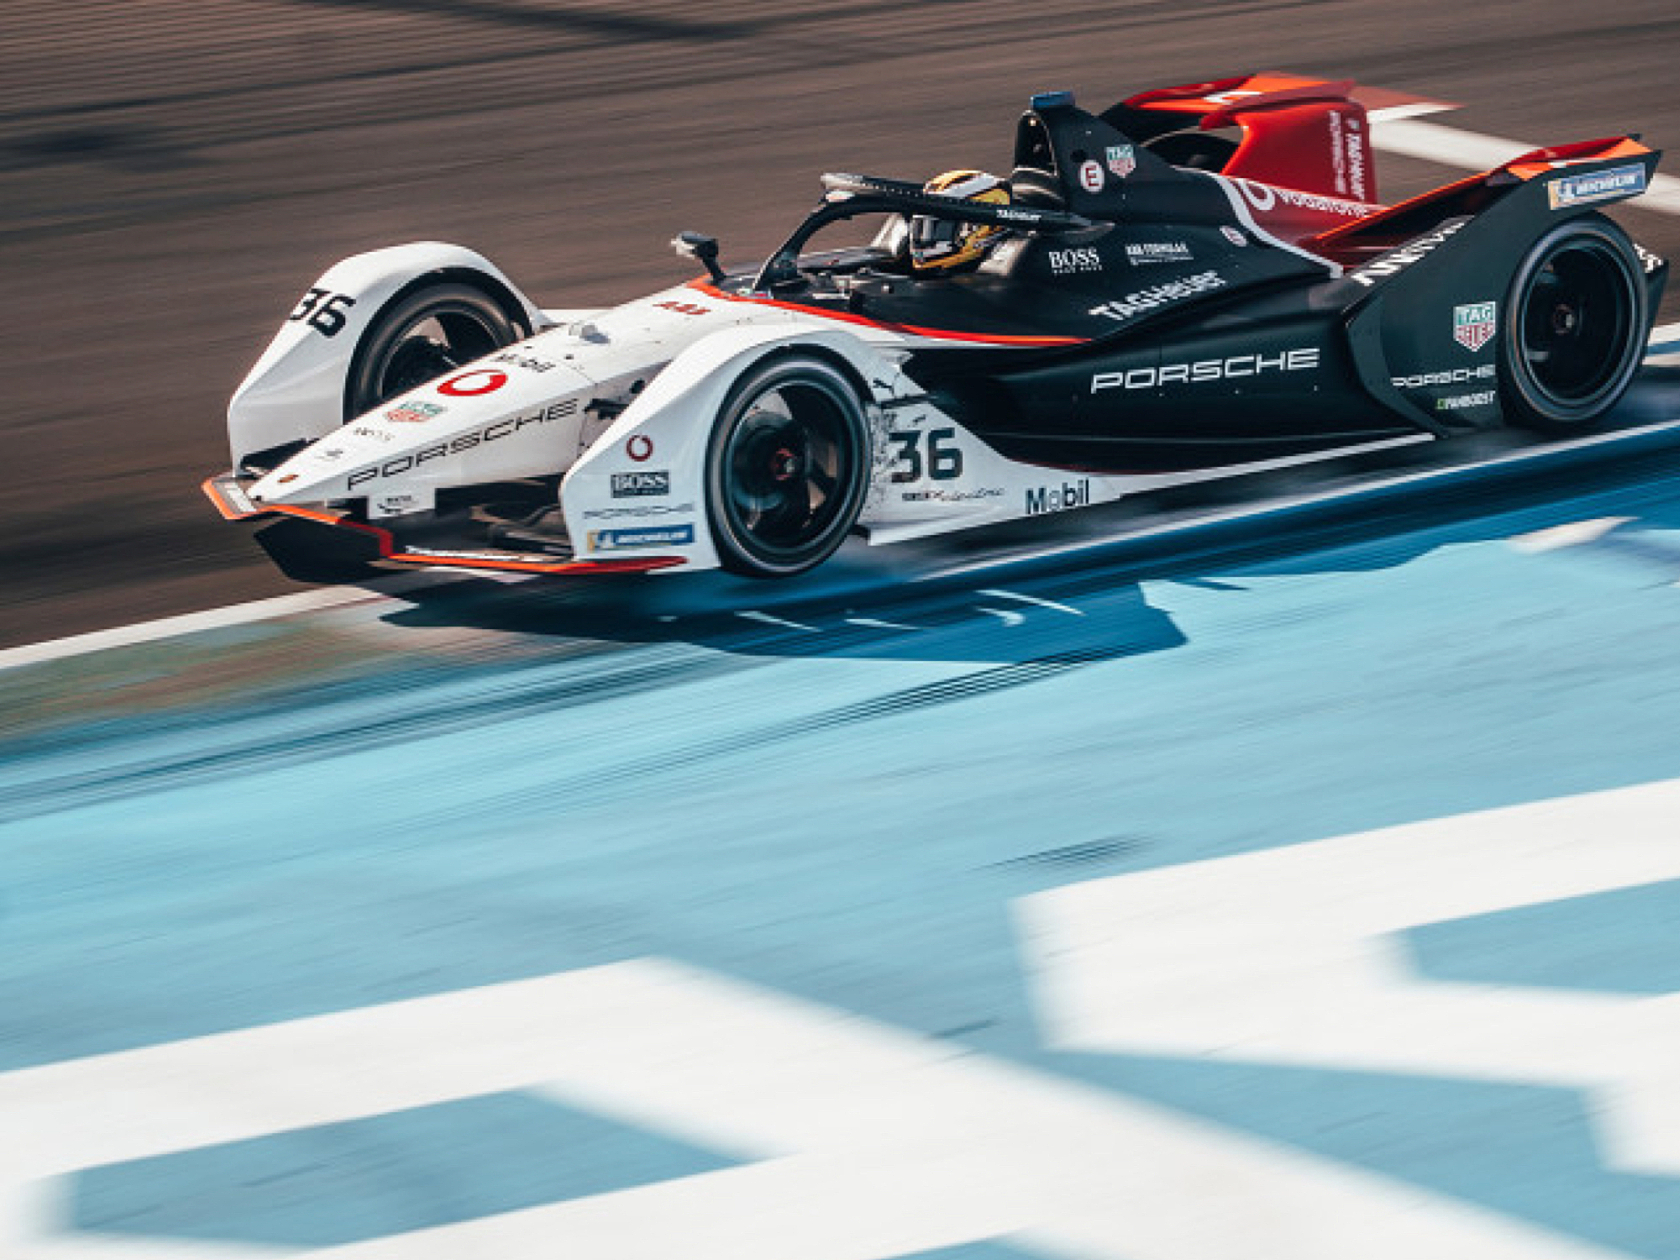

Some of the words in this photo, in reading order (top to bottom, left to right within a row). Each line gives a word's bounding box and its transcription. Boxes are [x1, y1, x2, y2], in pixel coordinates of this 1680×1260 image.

[1049, 247, 1101, 269] BOSS
[289, 287, 356, 337] 36
[1459, 305, 1493, 324] TAG
[1089, 347, 1321, 395] PORSCHE
[347, 398, 579, 491] PORSCHE
[888, 426, 964, 484] 36
